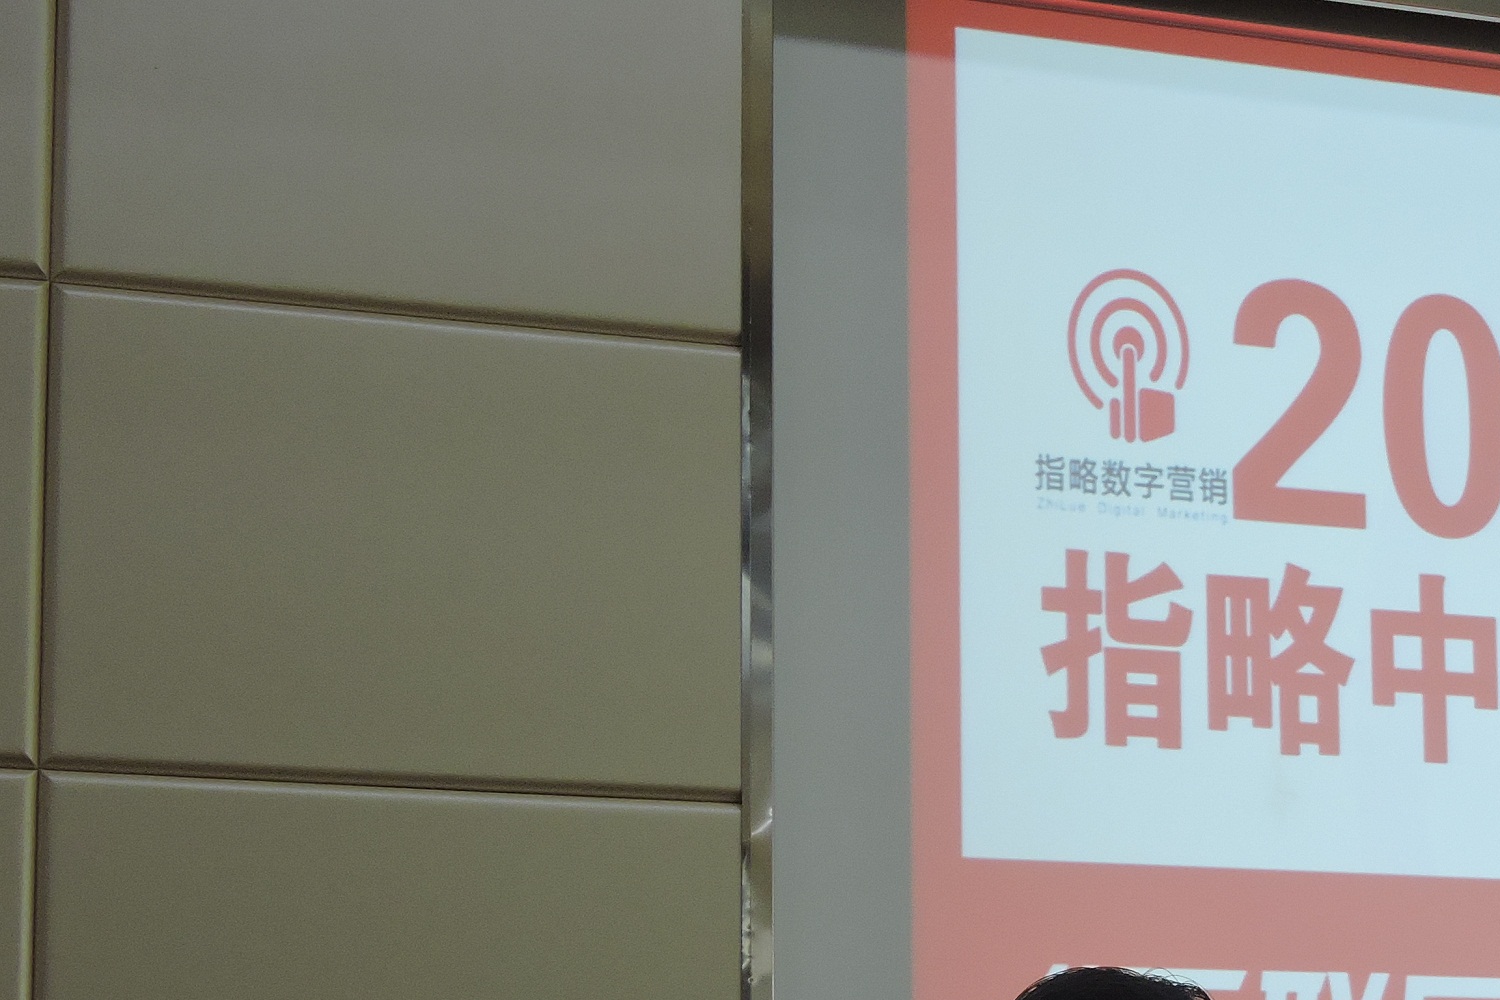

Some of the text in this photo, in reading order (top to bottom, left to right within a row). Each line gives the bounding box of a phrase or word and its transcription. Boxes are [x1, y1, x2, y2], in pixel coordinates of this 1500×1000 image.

[1035, 453, 1228, 505] 指略数字营销
[1098, 502, 1145, 518] Digital
[1157, 506, 1229, 525] Marketing
